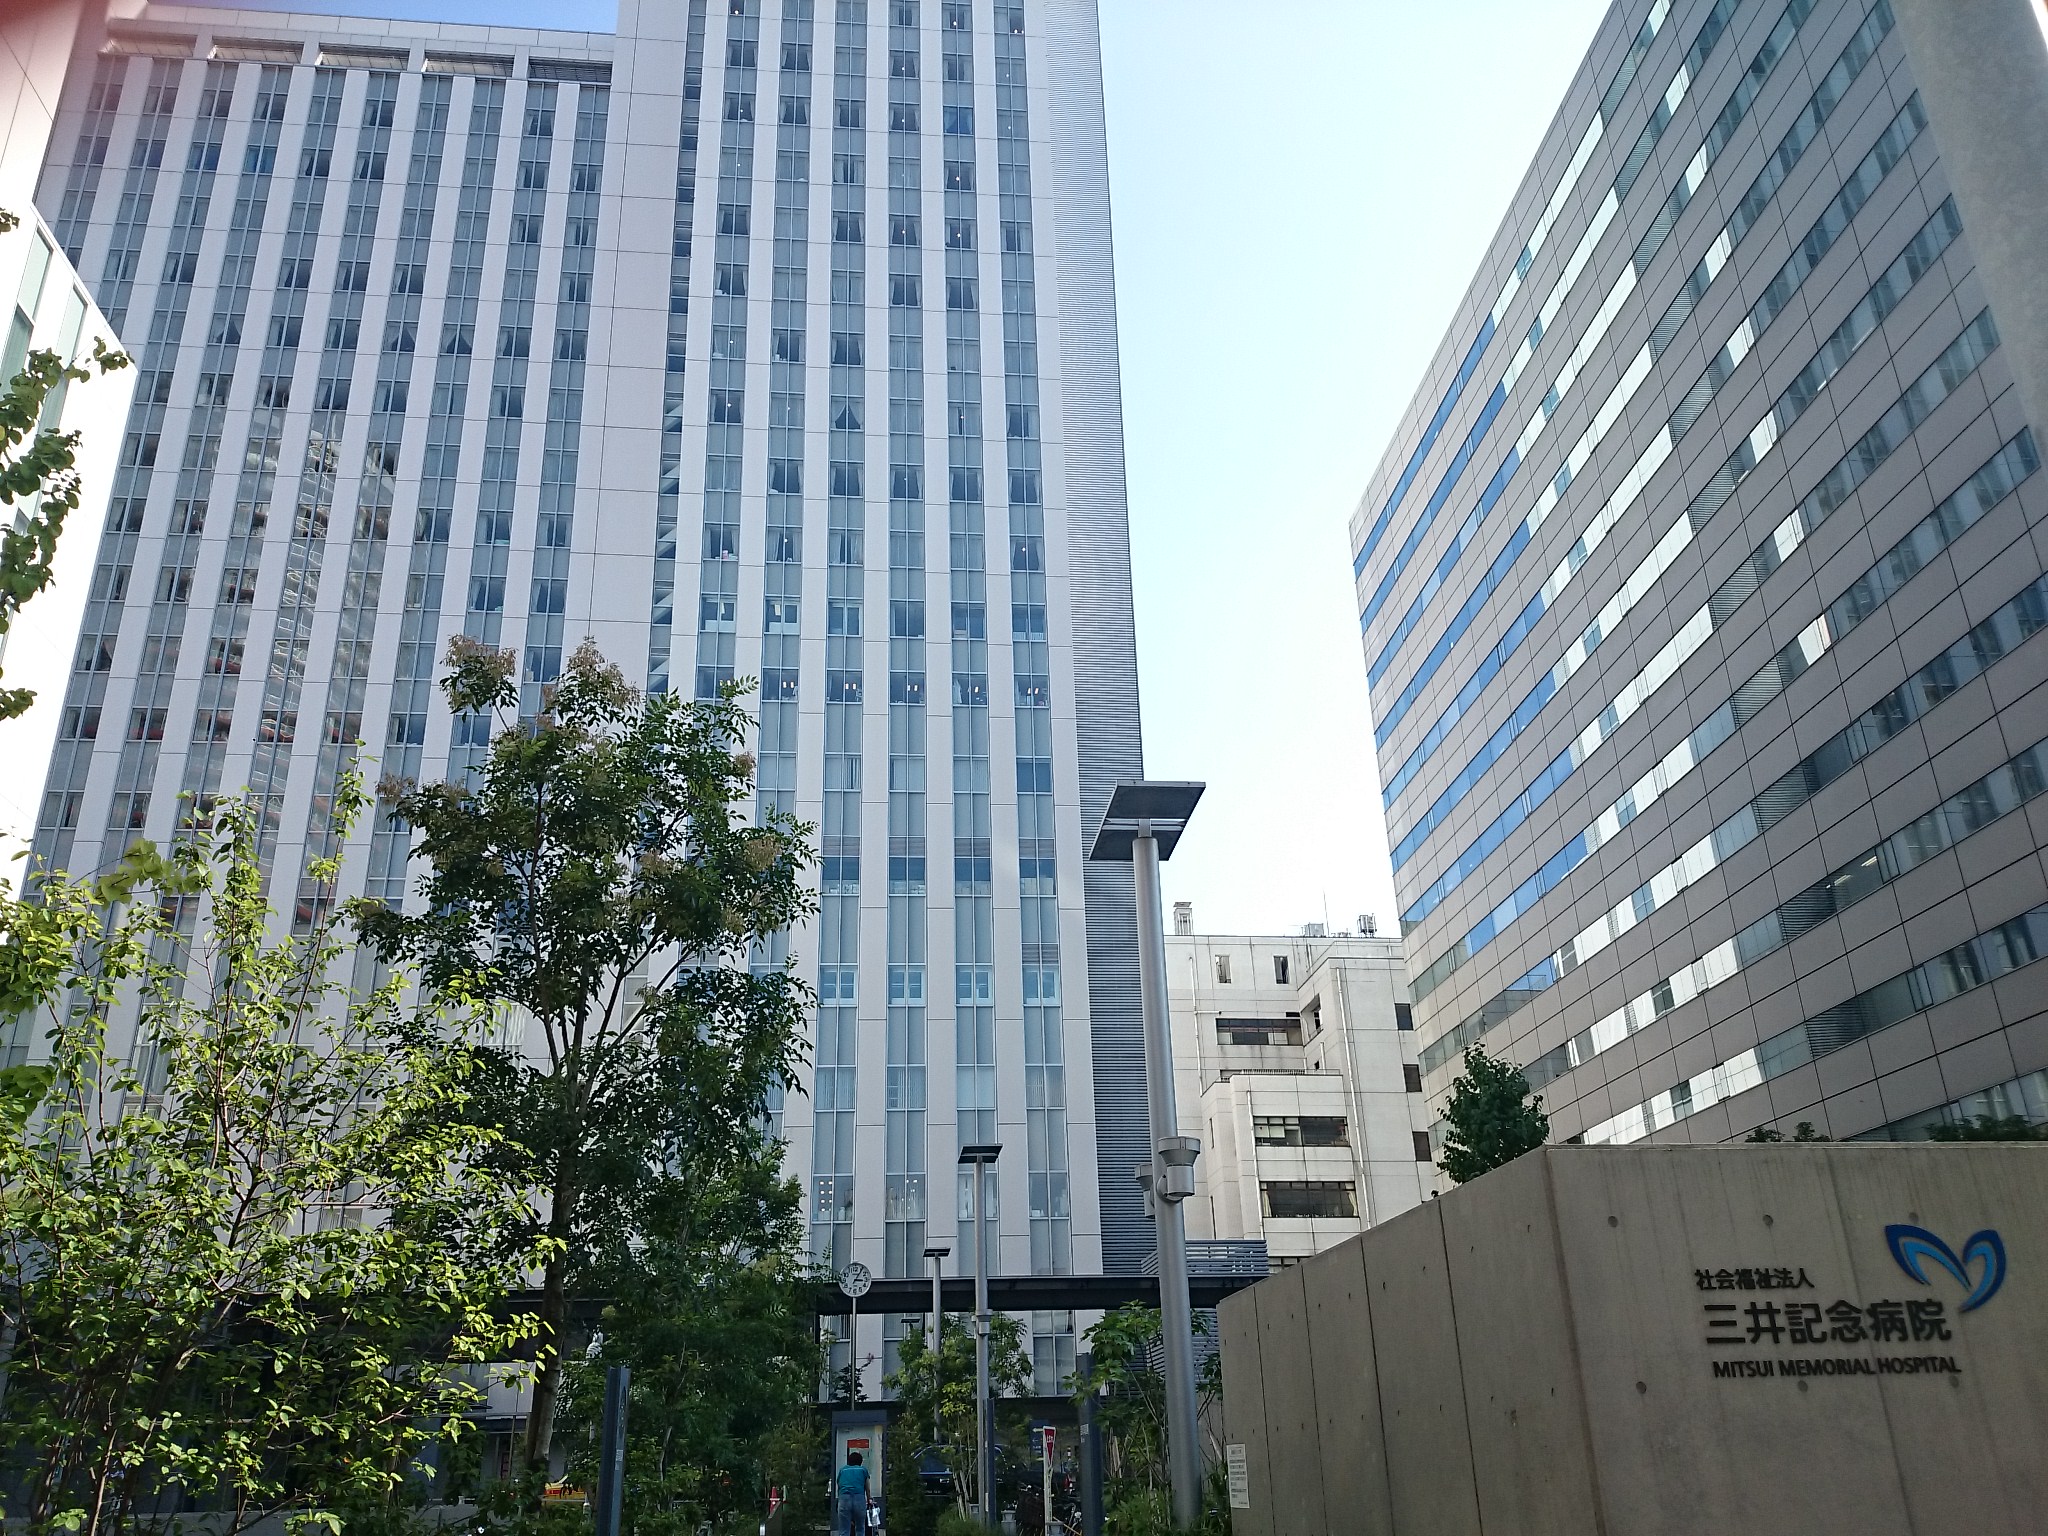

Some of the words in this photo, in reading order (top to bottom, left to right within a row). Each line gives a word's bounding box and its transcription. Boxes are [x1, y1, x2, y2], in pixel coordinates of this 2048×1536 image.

[1695, 1268, 1815, 1290] 社会福祉法人
[1703, 1300, 1952, 1345] 三井記念病院
[1713, 1360, 1774, 1378] MITSUI
[1778, 1358, 1876, 1377] MEMORIAL
[1877, 1356, 1962, 1374] HOSPITAL
